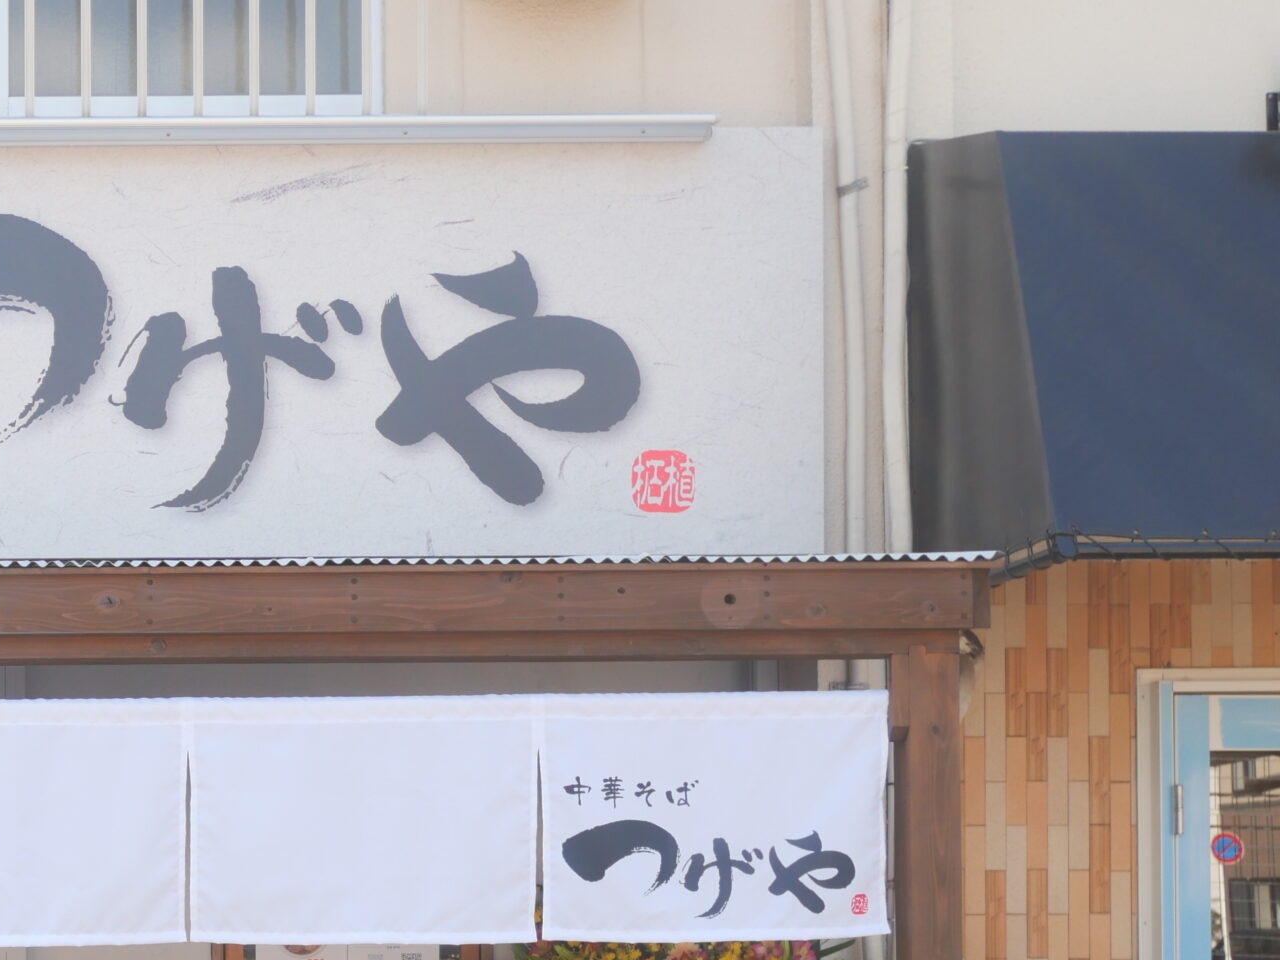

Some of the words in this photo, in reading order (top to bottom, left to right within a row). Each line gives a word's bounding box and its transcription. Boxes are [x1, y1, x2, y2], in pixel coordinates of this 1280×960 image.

[563, 776, 699, 808] 中華そば
[562, 819, 856, 919] つげや
